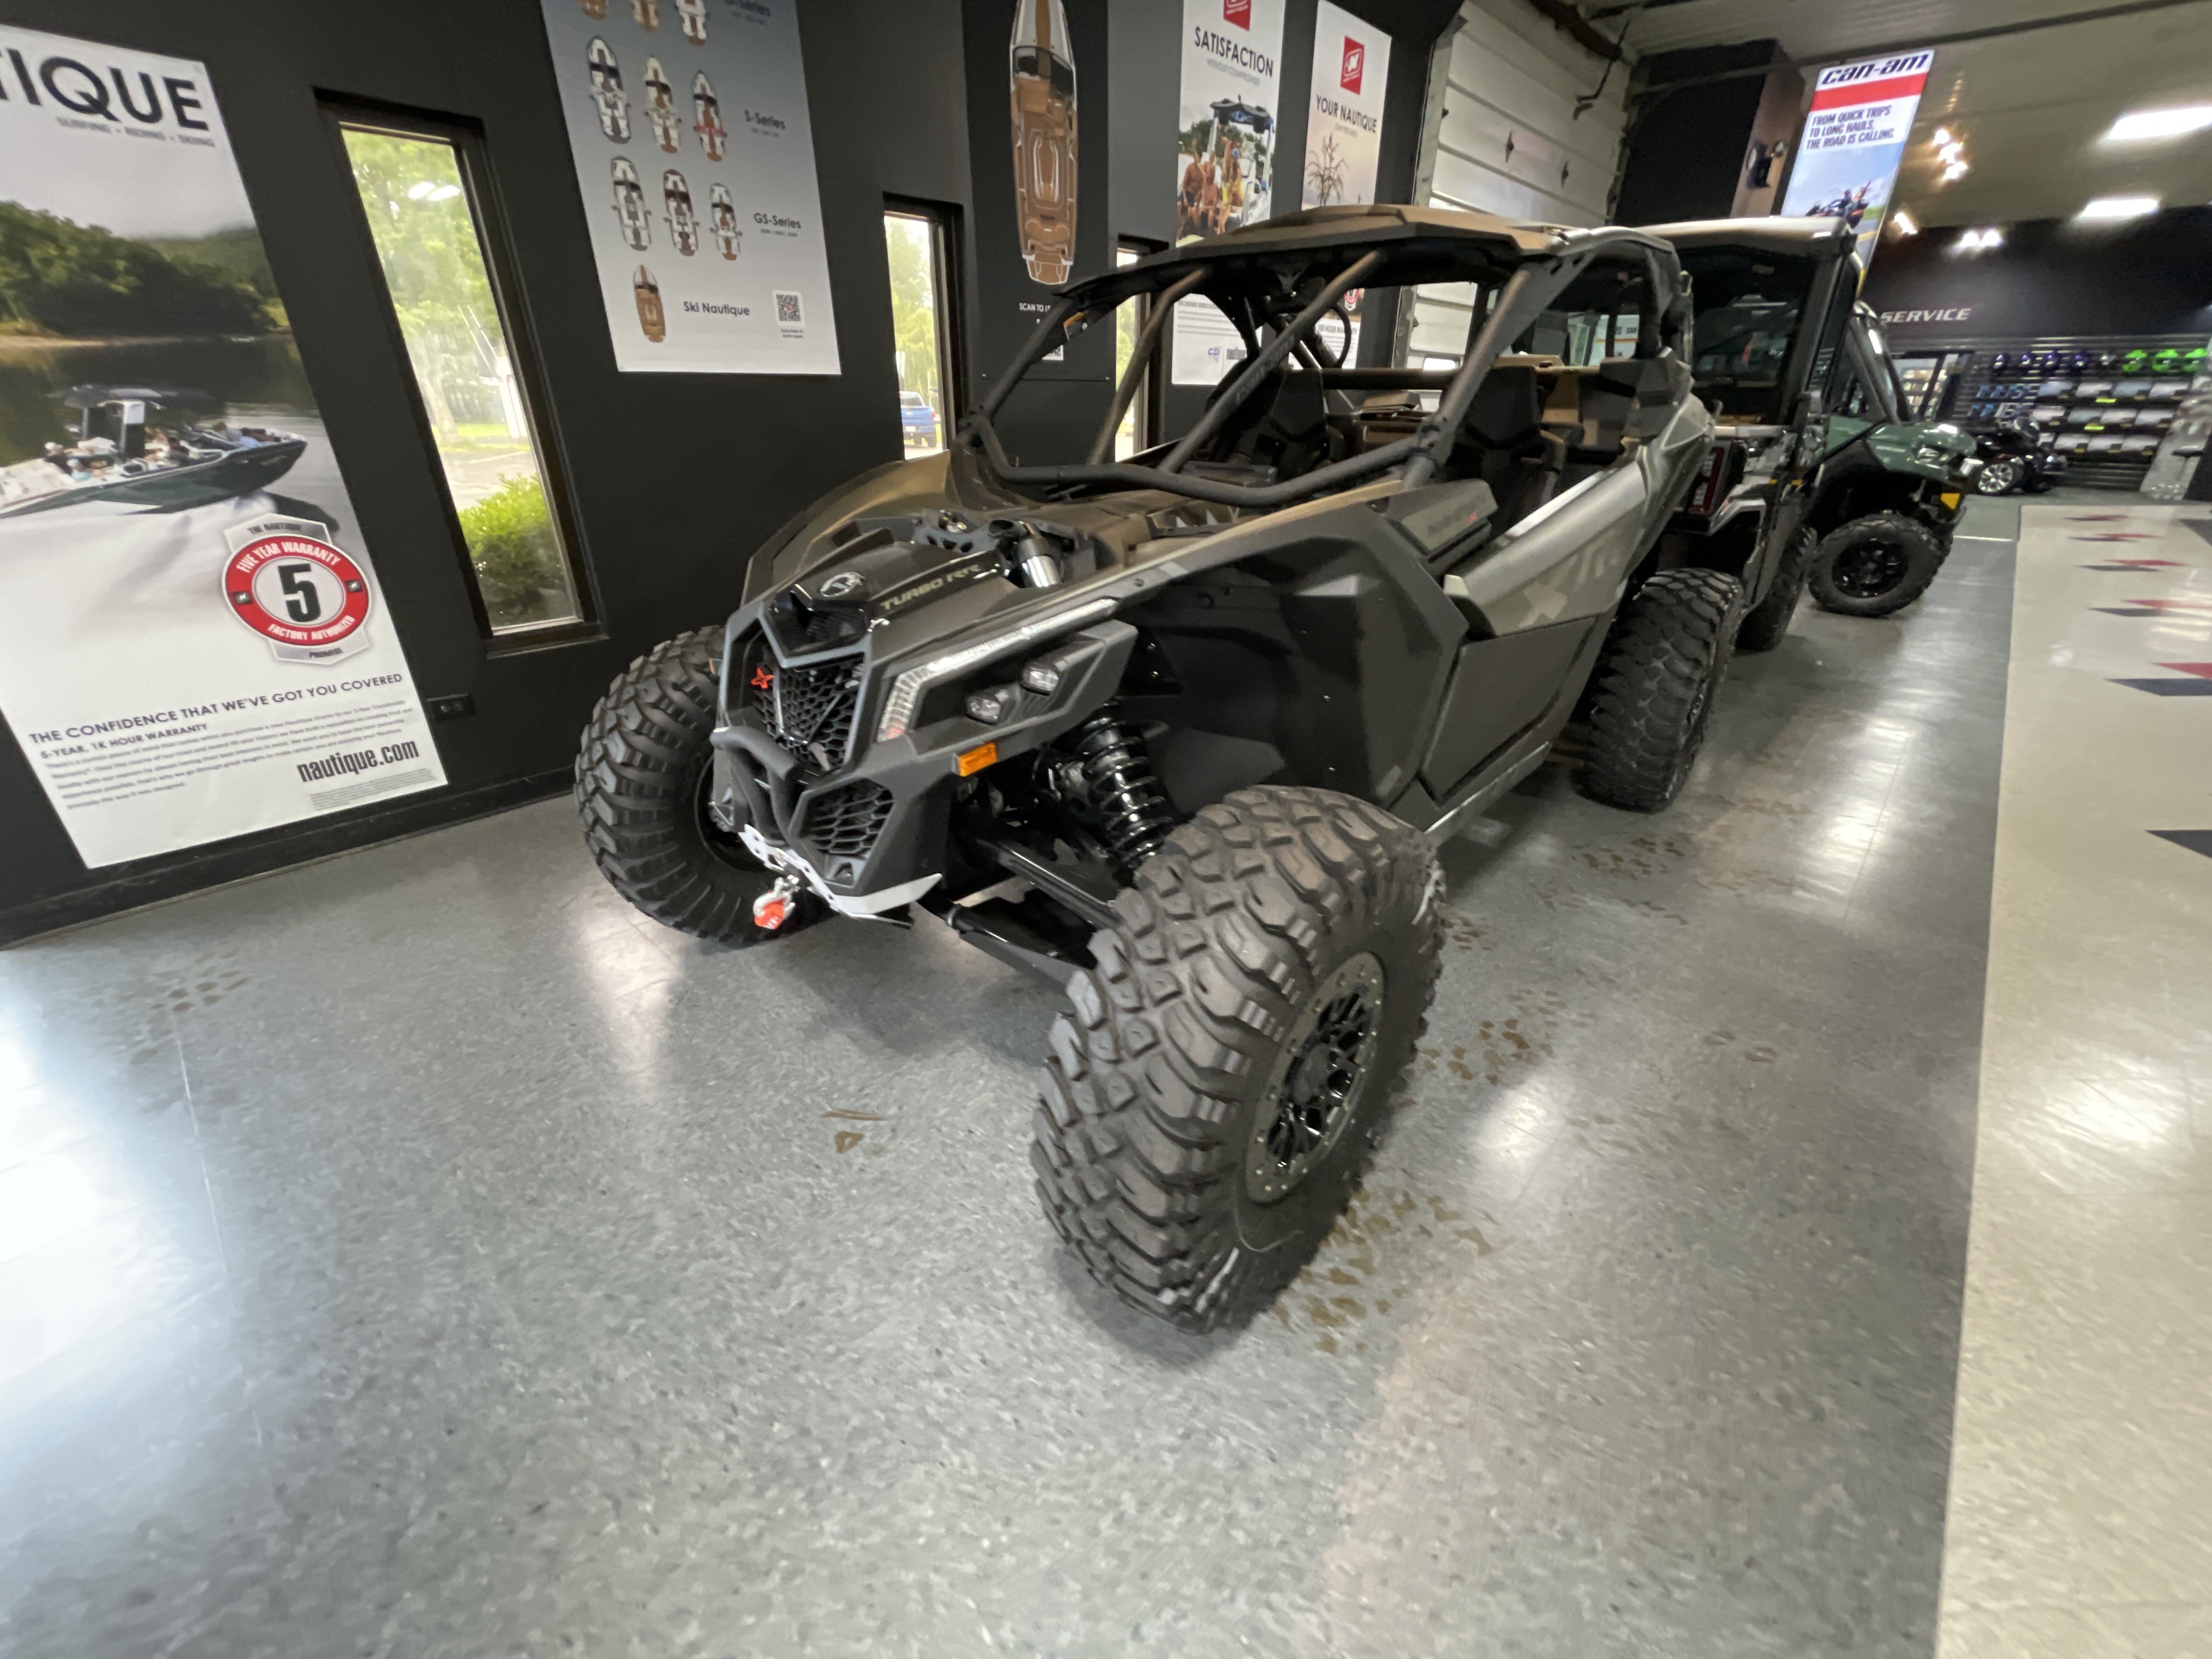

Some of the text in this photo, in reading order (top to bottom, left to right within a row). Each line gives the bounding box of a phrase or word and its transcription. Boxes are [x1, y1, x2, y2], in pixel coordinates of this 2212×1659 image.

[1194, 26, 1273, 77] SATISFACTION
[1821, 54, 1929, 85] can-am
[744, 110, 786, 129] S-Series
[1317, 94, 1377, 133] YOUR NAUTIQUE
[1812, 105, 1892, 126] FROM QUICK TRIPS
[1807, 140, 1820, 150] THE
[1822, 136, 1846, 148] ROAD
[1847, 134, 1856, 144] IS
[1810, 127, 1820, 138] TO
[1822, 124, 1844, 136] LONG
[754, 212, 801, 229] GS-Series
[683, 301, 750, 317] Ski Nautique
[1019, 302, 1036, 312] SCAN
[1036, 304, 1044, 312] TO
[1880, 308, 1971, 323] SERVICE
[236, 541, 342, 573] FIVE YEAR WARRANTY
[278, 563, 321, 623] 5
[267, 614, 356, 641] FACTORY AUTHORIZED
[29, 673, 403, 744] THE CONFIDENCE THAT WE'VE GOT YOU COVERED
[110, 735, 143, 747] HOUR
[145, 723, 208, 740] WARRANTY
[297, 740, 420, 782] nautique.com
